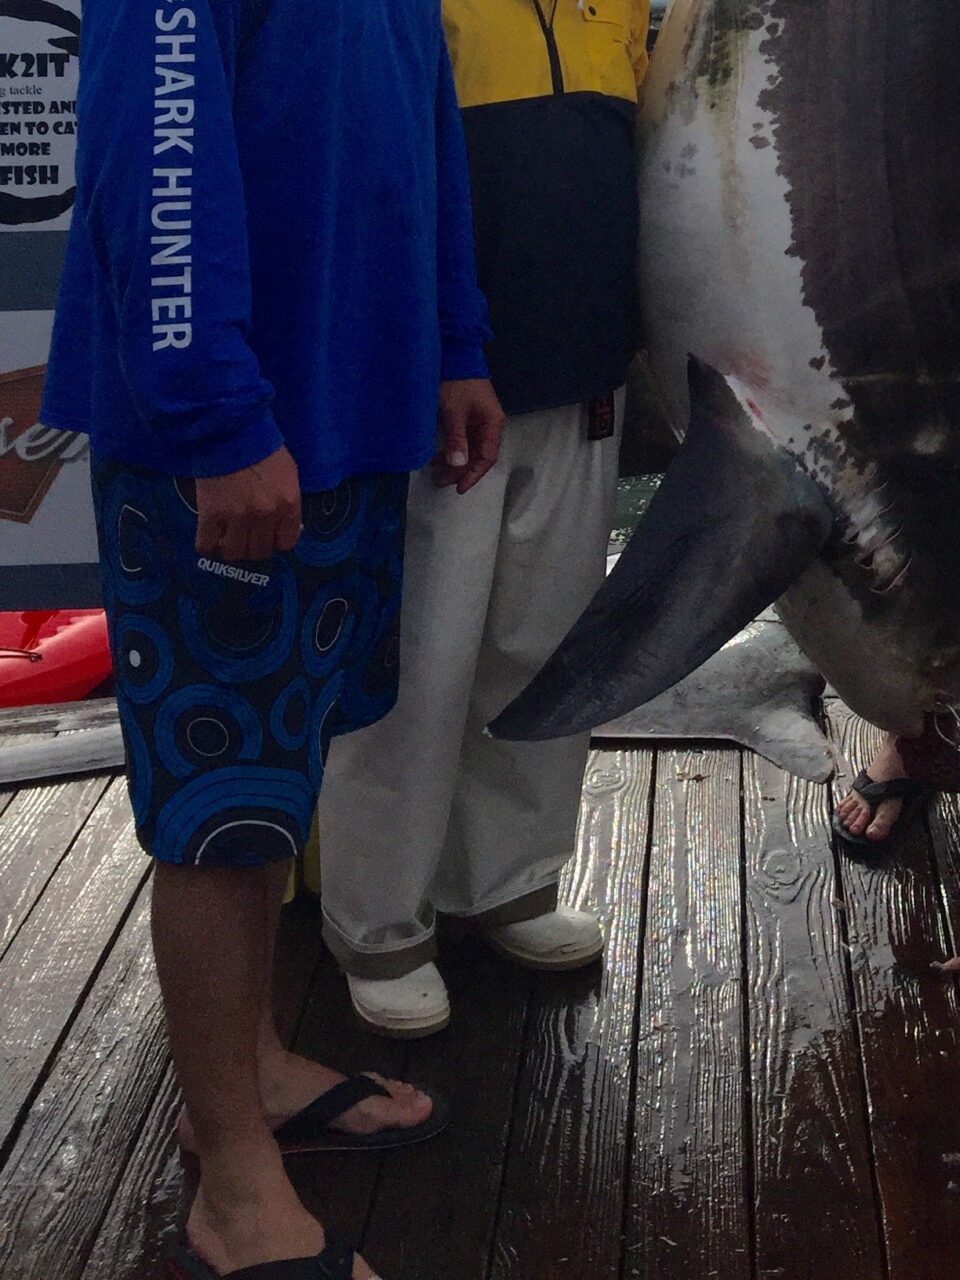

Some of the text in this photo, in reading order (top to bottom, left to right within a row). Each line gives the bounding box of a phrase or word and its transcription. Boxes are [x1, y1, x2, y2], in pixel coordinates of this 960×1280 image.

[9, 85, 43, 95] tackle
[0, 100, 46, 116] STED
[25, 121, 49, 136] TO
[53, 121, 78, 136] CA
[0, 141, 51, 157] MORE
[0, 164, 59, 186] FISH
[150, 8, 197, 353] SHARK HUNTER
[197, 557, 270, 587] QUIKSILVER
